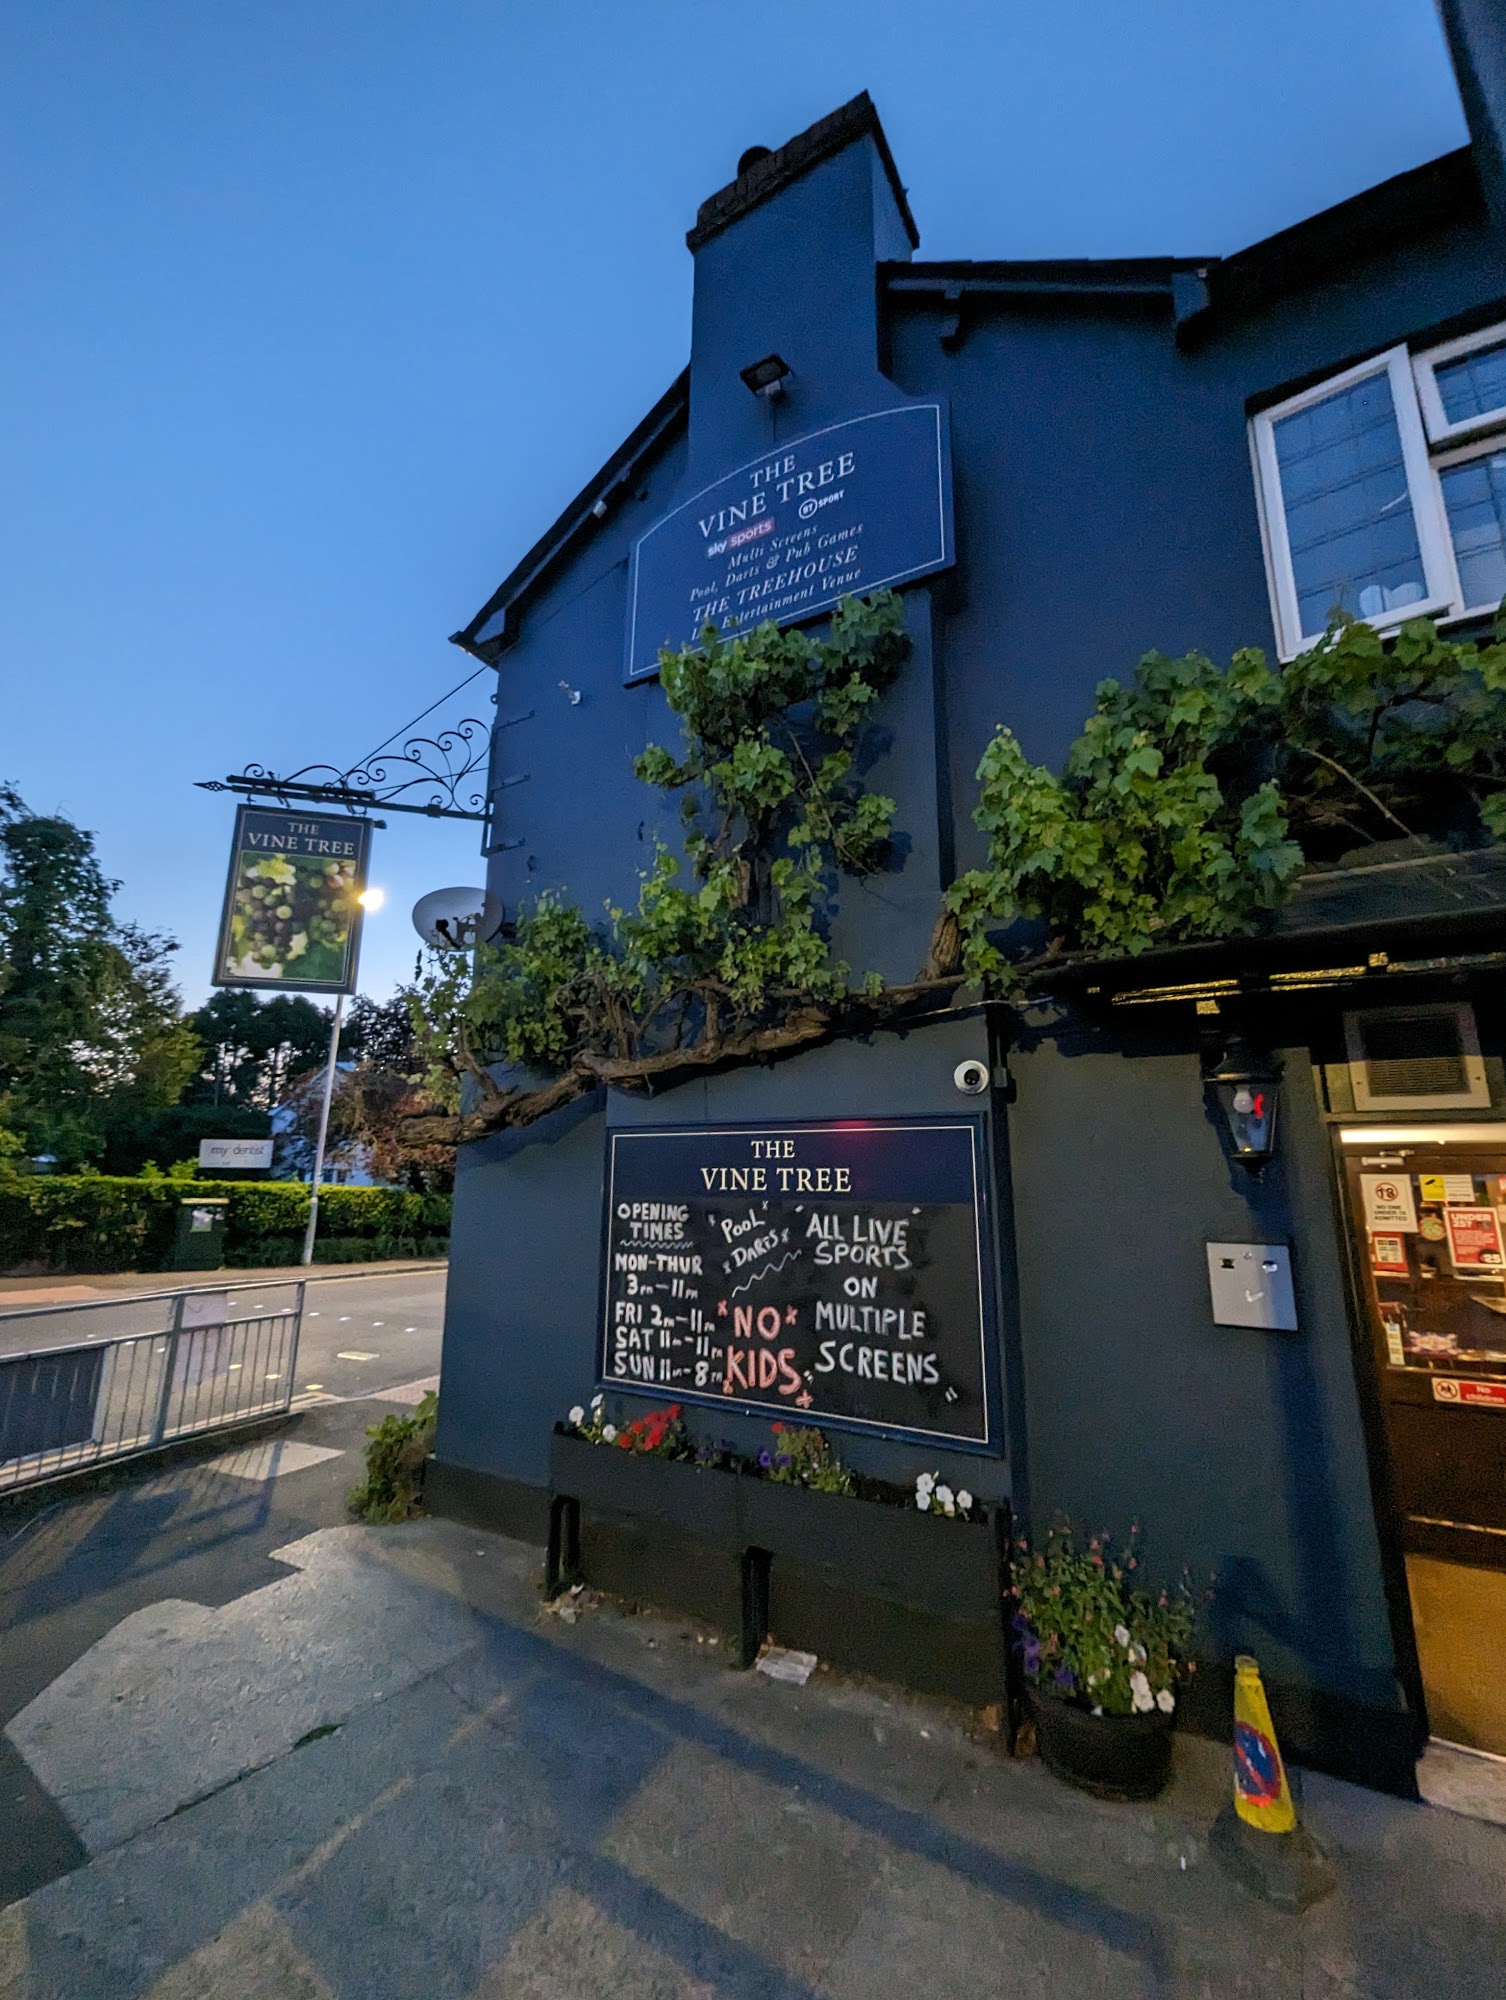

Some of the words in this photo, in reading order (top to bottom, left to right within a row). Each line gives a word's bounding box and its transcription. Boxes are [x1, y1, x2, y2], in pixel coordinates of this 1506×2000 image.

[750, 455, 796, 488] THE
[698, 492, 767, 538] VINE
[776, 452, 857, 504] TREE
[818, 489, 845, 509] SPORT
[707, 540, 728, 557] sky
[730, 520, 773, 547] sports
[727, 544, 765, 570] Multi
[769, 524, 818, 551] Screens
[689, 581, 718, 602] Pool,
[724, 566, 760, 588] Darts
[765, 554, 780, 570] &
[785, 542, 811, 563] Pub
[817, 523, 864, 550] Games
[693, 596, 731, 622] THE
[736, 545, 859, 605] TREEHOUSE
[721, 585, 814, 629] Etertainment
[821, 568, 862, 591] Venue
[248, 832, 298, 849] VINE
[305, 838, 355, 855] TREE
[288, 822, 320, 835] THE
[750, 1140, 796, 1159] THE
[701, 1167, 767, 1192] VINE
[776, 1167, 852, 1193] TREE
[1377, 1187, 1396, 1199] 18
[617, 1202, 690, 1222] OPENING
[1450, 1213, 1492, 1222] UNDER
[629, 1221, 685, 1241] TIMES
[805, 1212, 845, 1240] ALL
[853, 1215, 910, 1245] LIVE
[814, 1240, 913, 1271] SPORTS
[844, 1276, 878, 1299] ON
[615, 1301, 643, 1325] FRI
[733, 1305, 781, 1340] NO
[815, 1301, 926, 1341] MULTIPLE
[615, 1325, 654, 1352] SAT
[614, 1351, 655, 1381] SUN
[726, 1345, 801, 1396] KIDS
[814, 1341, 939, 1385] SCREENS
